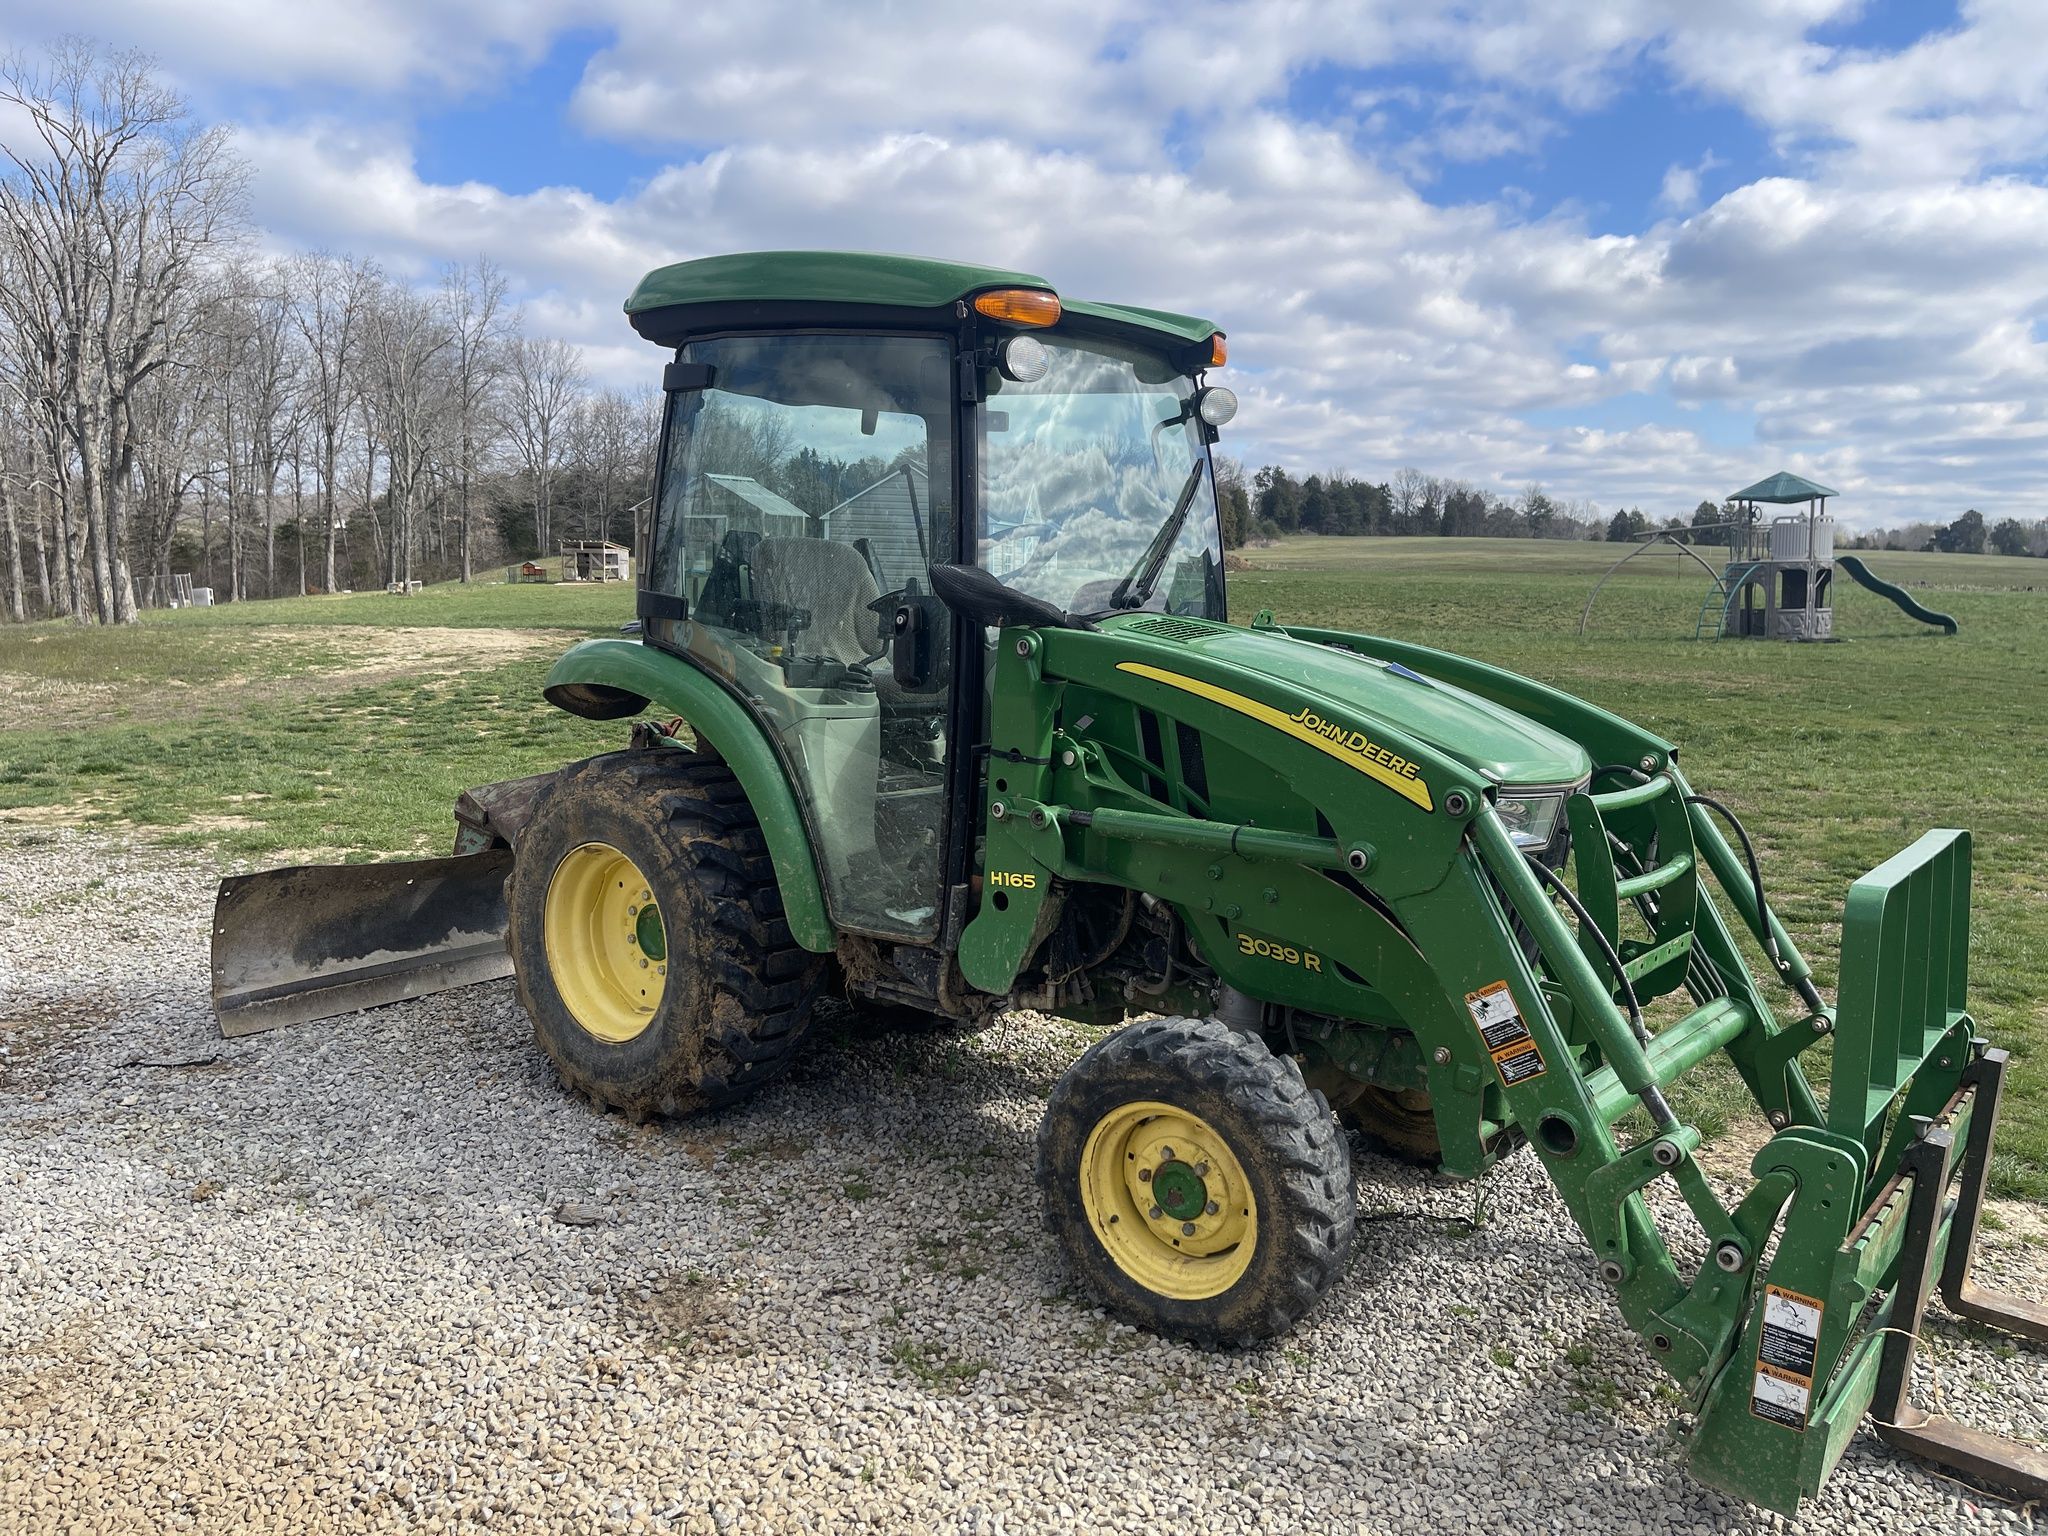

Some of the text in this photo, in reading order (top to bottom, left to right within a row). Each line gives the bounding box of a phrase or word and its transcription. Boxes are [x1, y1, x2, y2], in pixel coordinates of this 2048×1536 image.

[990, 870, 1036, 889] H165
[1237, 933, 1322, 973] 3039 R
[1503, 1042, 1532, 1058] WARNING
[1782, 1290, 1819, 1308] WARNING
[1771, 1369, 1806, 1387] WARNING
